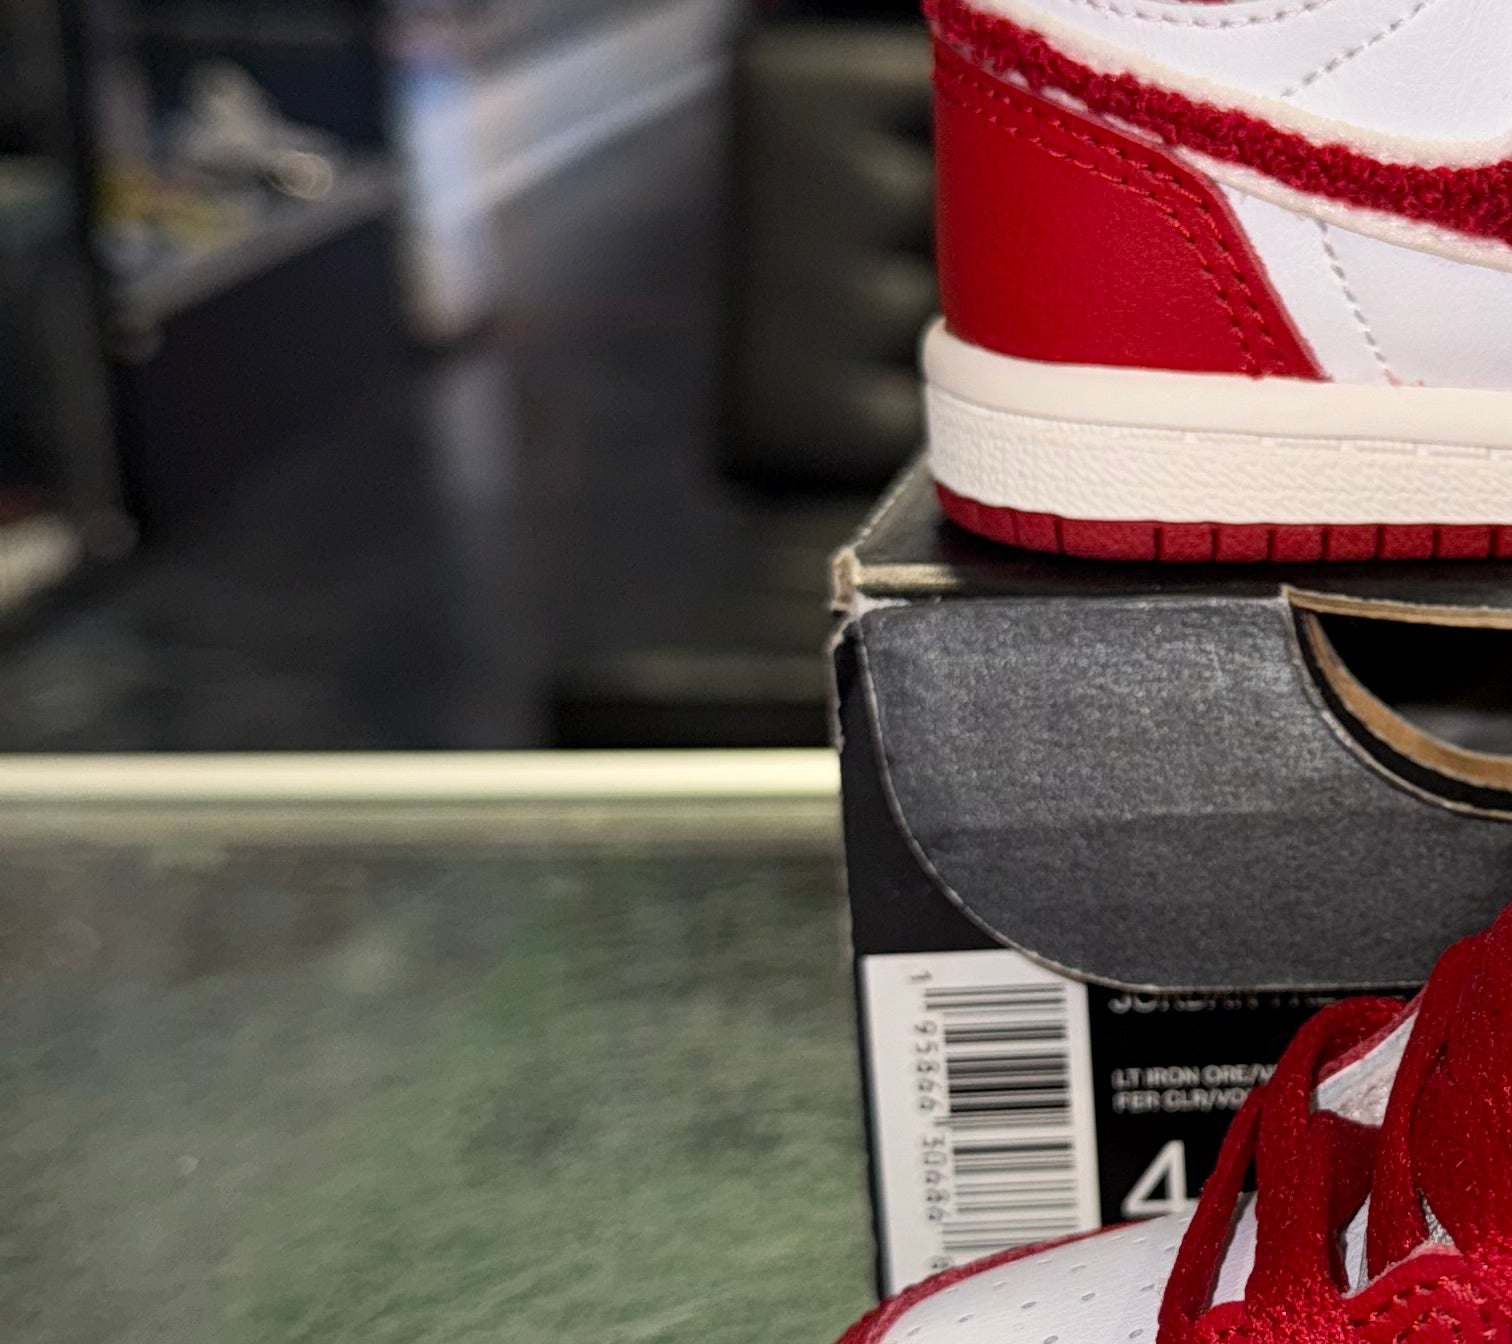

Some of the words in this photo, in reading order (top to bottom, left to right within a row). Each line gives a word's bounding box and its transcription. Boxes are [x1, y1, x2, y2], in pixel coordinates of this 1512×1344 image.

[1110, 1067, 1140, 1090] LT
[1142, 1066, 1200, 1089] IRON
[1201, 1063, 1277, 1088] ORE/V
[1161, 1087, 1251, 1113] CLR/VO
